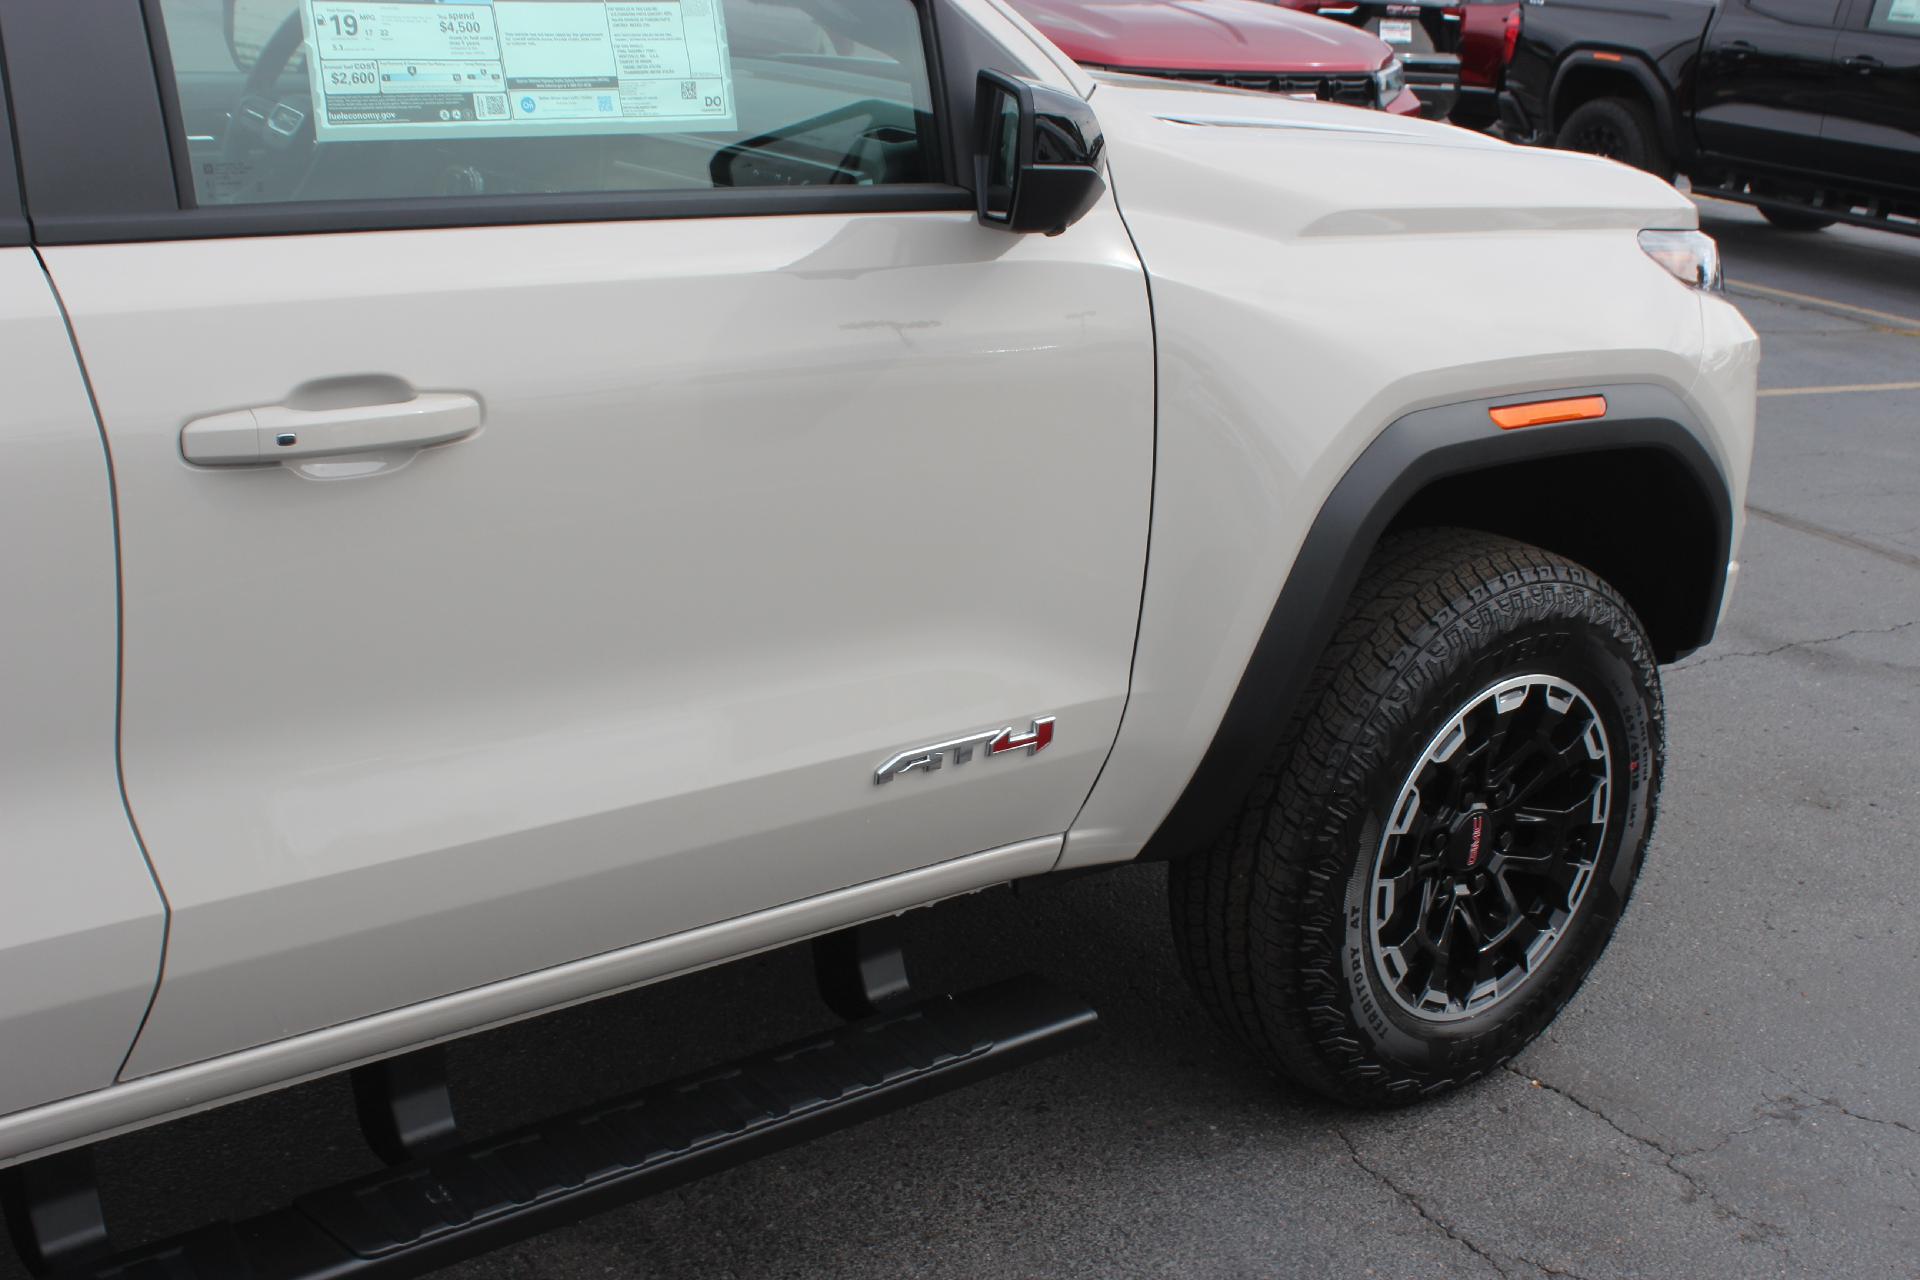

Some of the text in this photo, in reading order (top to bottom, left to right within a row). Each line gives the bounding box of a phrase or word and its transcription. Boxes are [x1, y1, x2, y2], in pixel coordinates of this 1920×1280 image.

[449, 11, 475, 21] spend
[329, 14, 358, 36] 19
[440, 21, 481, 34] $4,500
[354, 62, 376, 70] cost
[331, 72, 375, 85] $2,600
[705, 96, 721, 107] DO
[328, 112, 396, 121] fueleconomy.gov
[874, 716, 1056, 785] AT4
[1466, 815, 1484, 866] GMC
[1350, 905, 1388, 1039] TERRITORY AT
